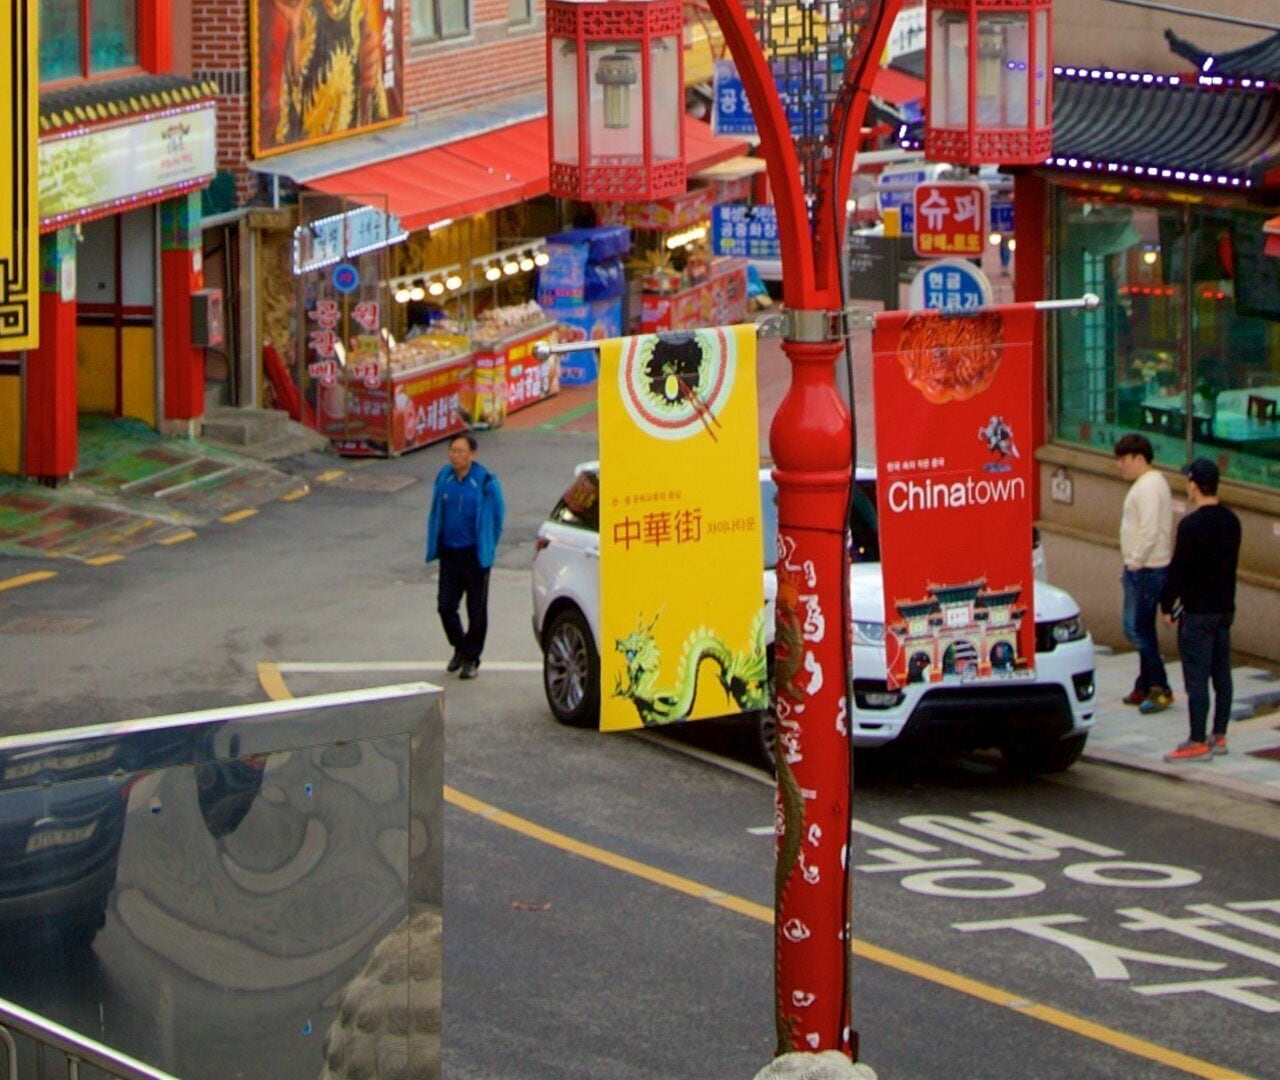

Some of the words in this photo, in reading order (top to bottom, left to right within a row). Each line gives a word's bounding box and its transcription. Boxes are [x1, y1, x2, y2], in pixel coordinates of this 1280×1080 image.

[919, 188, 980, 232] 슈퍼
[928, 272, 962, 290] 현금
[888, 475, 1025, 513] Chinatown
[613, 508, 702, 551] 中華街
[707, 516, 755, 535] 차이나타운
